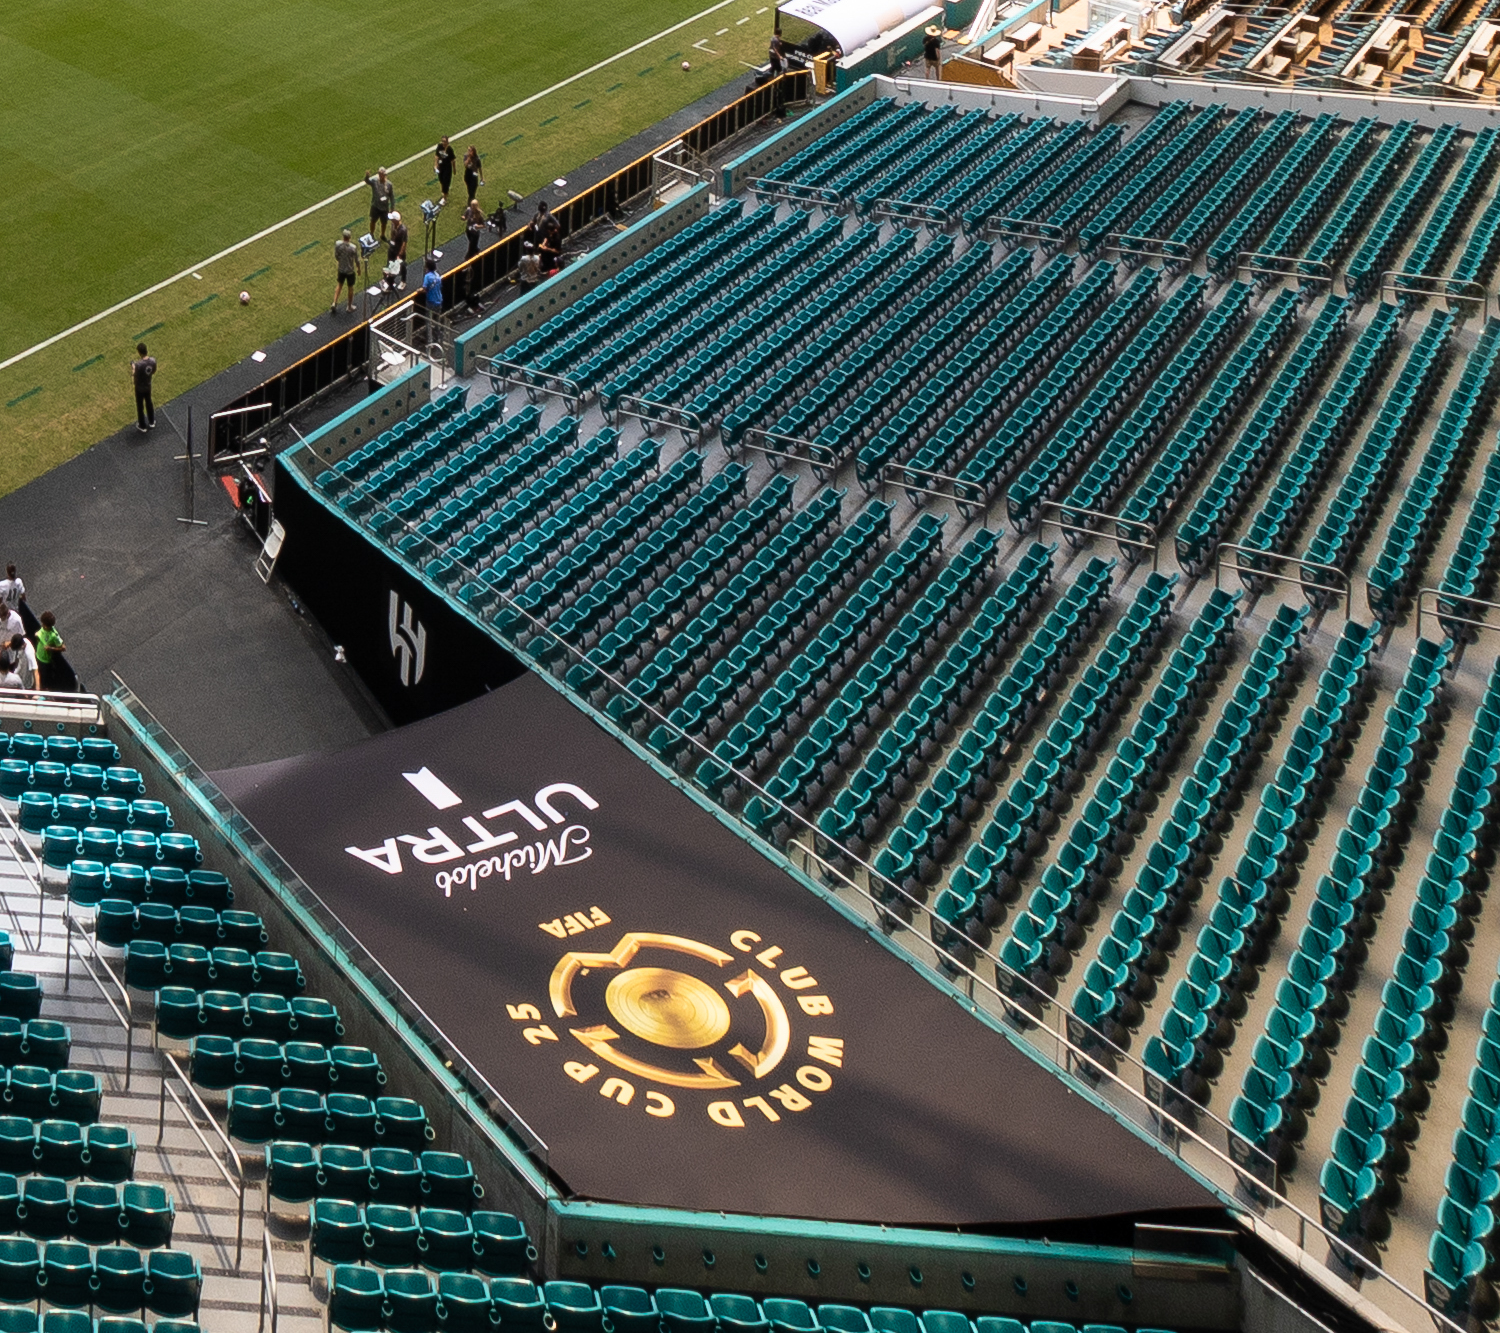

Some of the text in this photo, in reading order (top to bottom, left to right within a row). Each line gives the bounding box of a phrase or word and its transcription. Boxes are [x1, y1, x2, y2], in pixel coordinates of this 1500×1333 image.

[344, 782, 600, 875] ULTRA
[434, 824, 593, 898] Michelob
[538, 906, 612, 939] FIFA
[505, 929, 845, 1128] CLUB WORLD CUP 25
